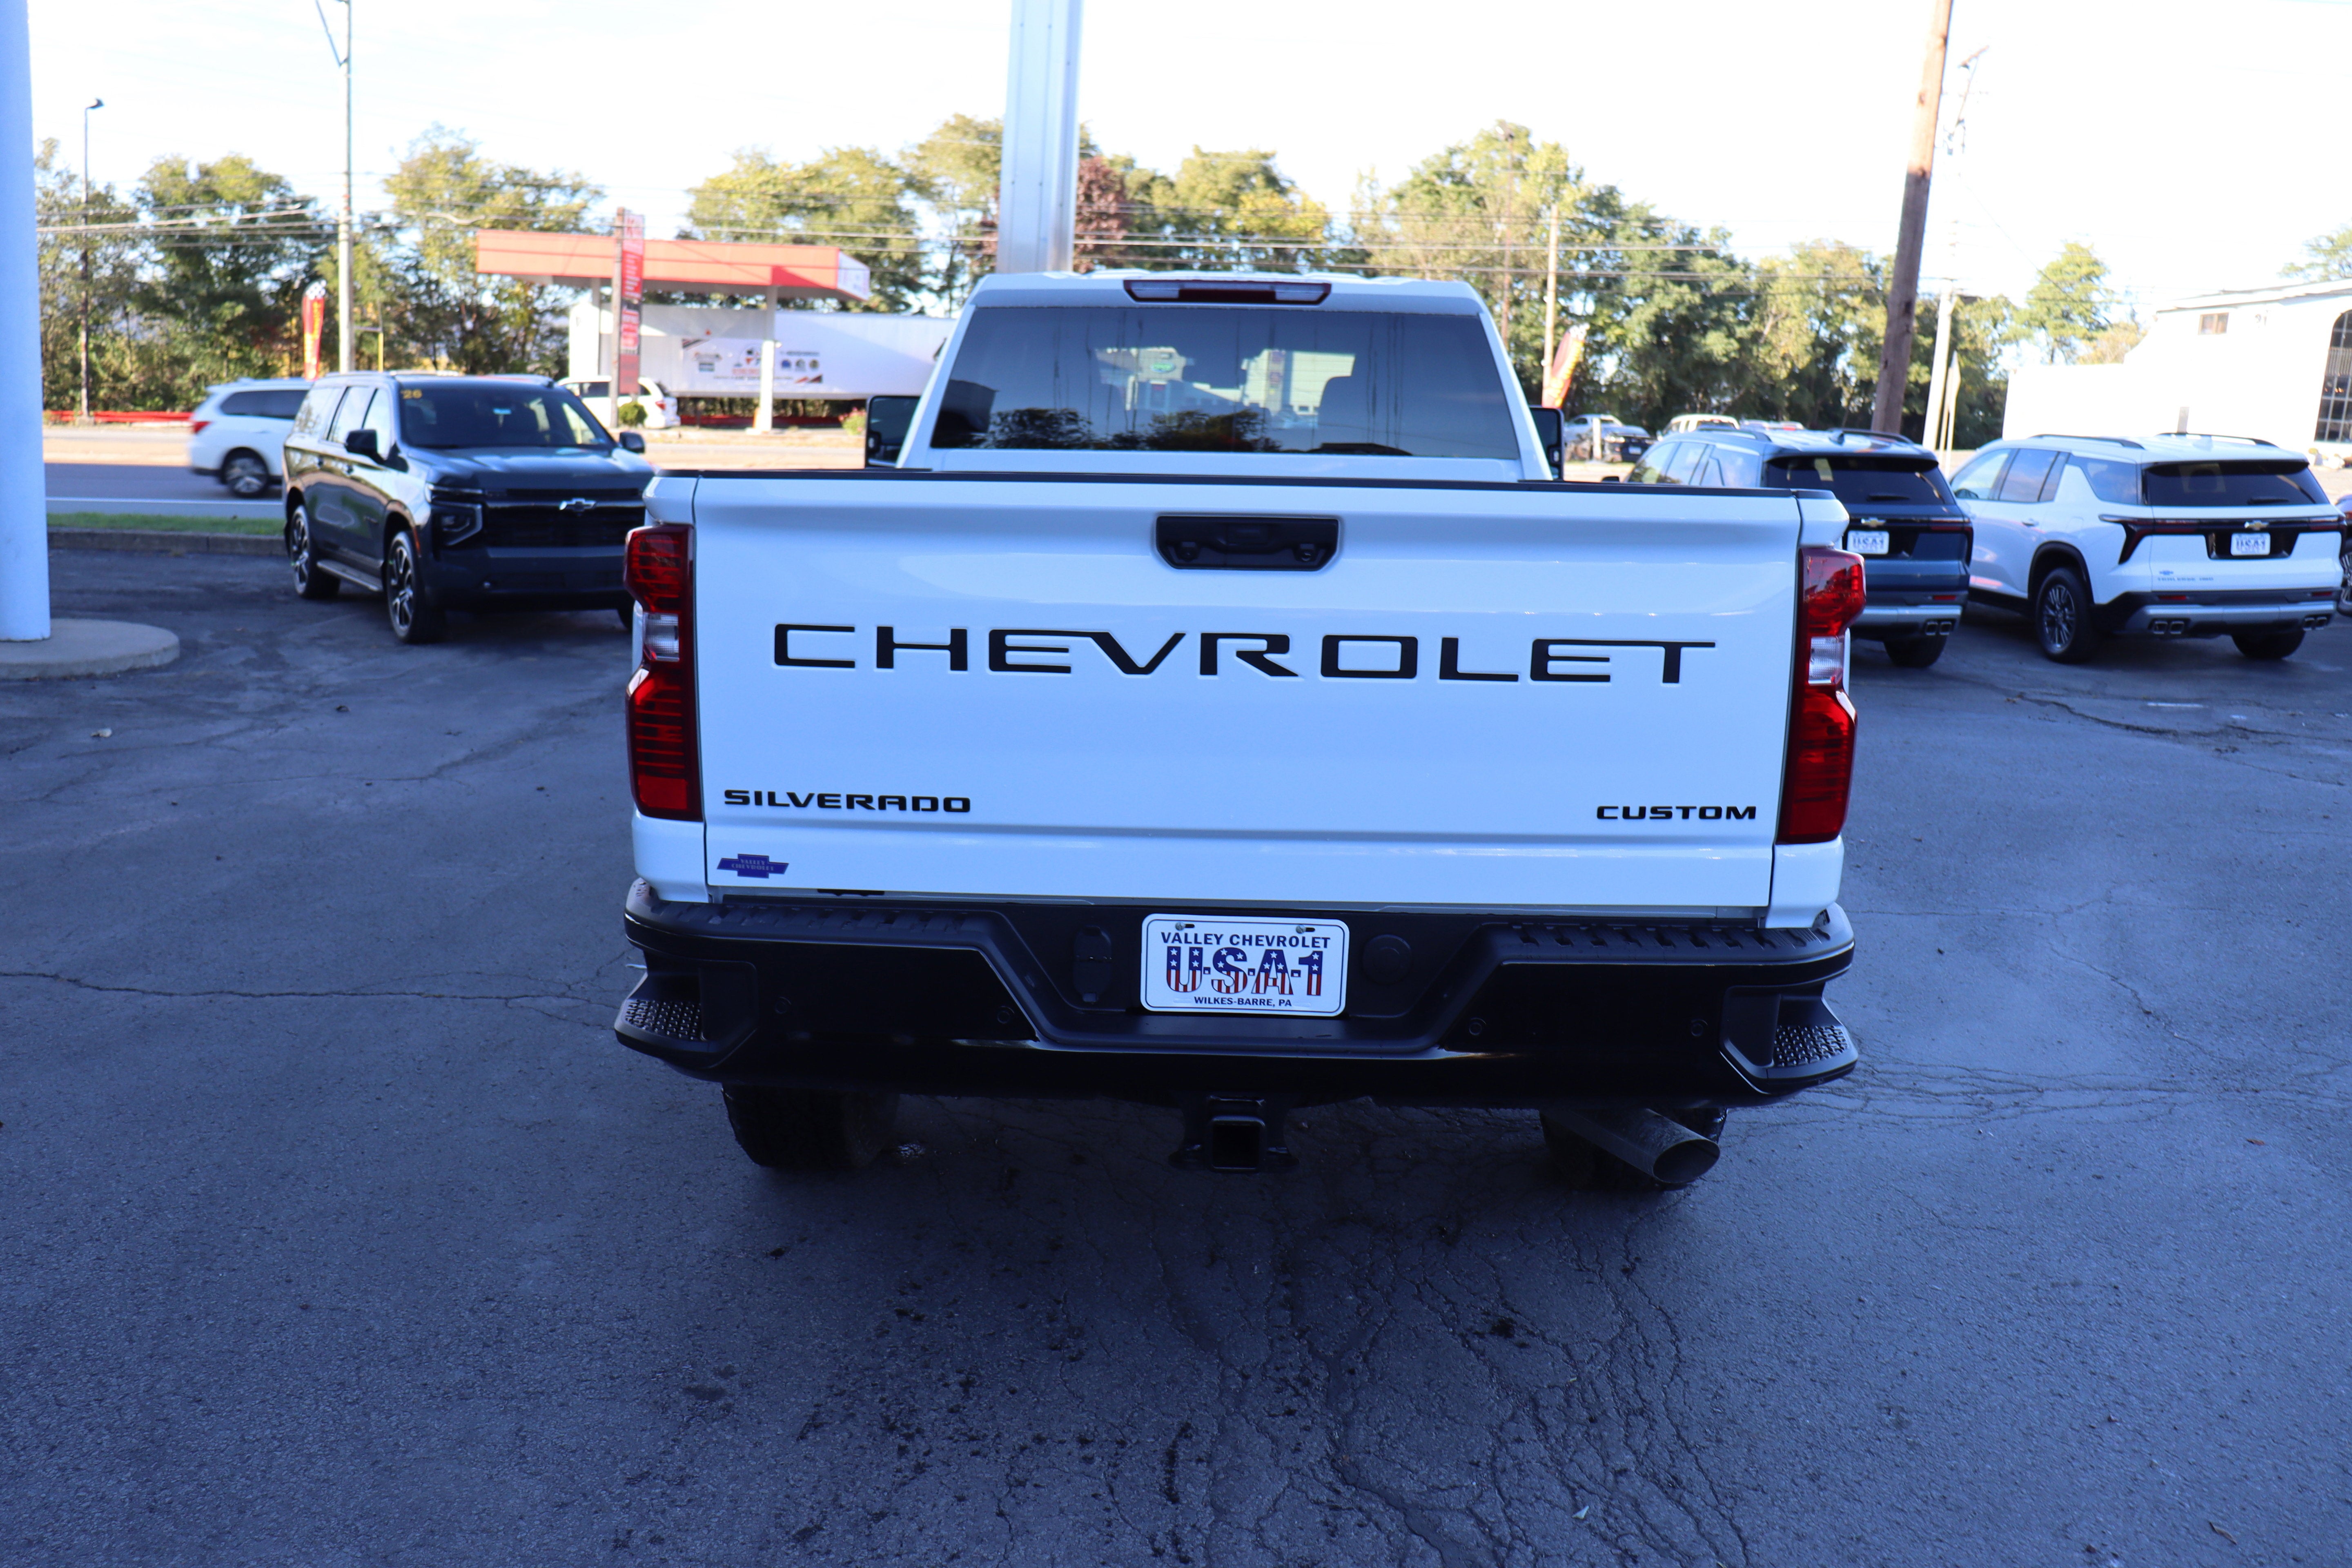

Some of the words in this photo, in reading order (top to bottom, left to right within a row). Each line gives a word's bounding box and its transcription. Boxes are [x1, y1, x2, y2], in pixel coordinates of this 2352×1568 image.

[774, 623, 1716, 684] CHEVROLET
[724, 789, 971, 813] SILVERADO
[1596, 806, 1757, 820] CUSTOM
[1160, 931, 1224, 945] VALLEY
[1229, 934, 1331, 949] CHEVROLET
[1194, 996, 1275, 1008] WILKES-BARRE,
[1278, 999, 1292, 1007] PA
